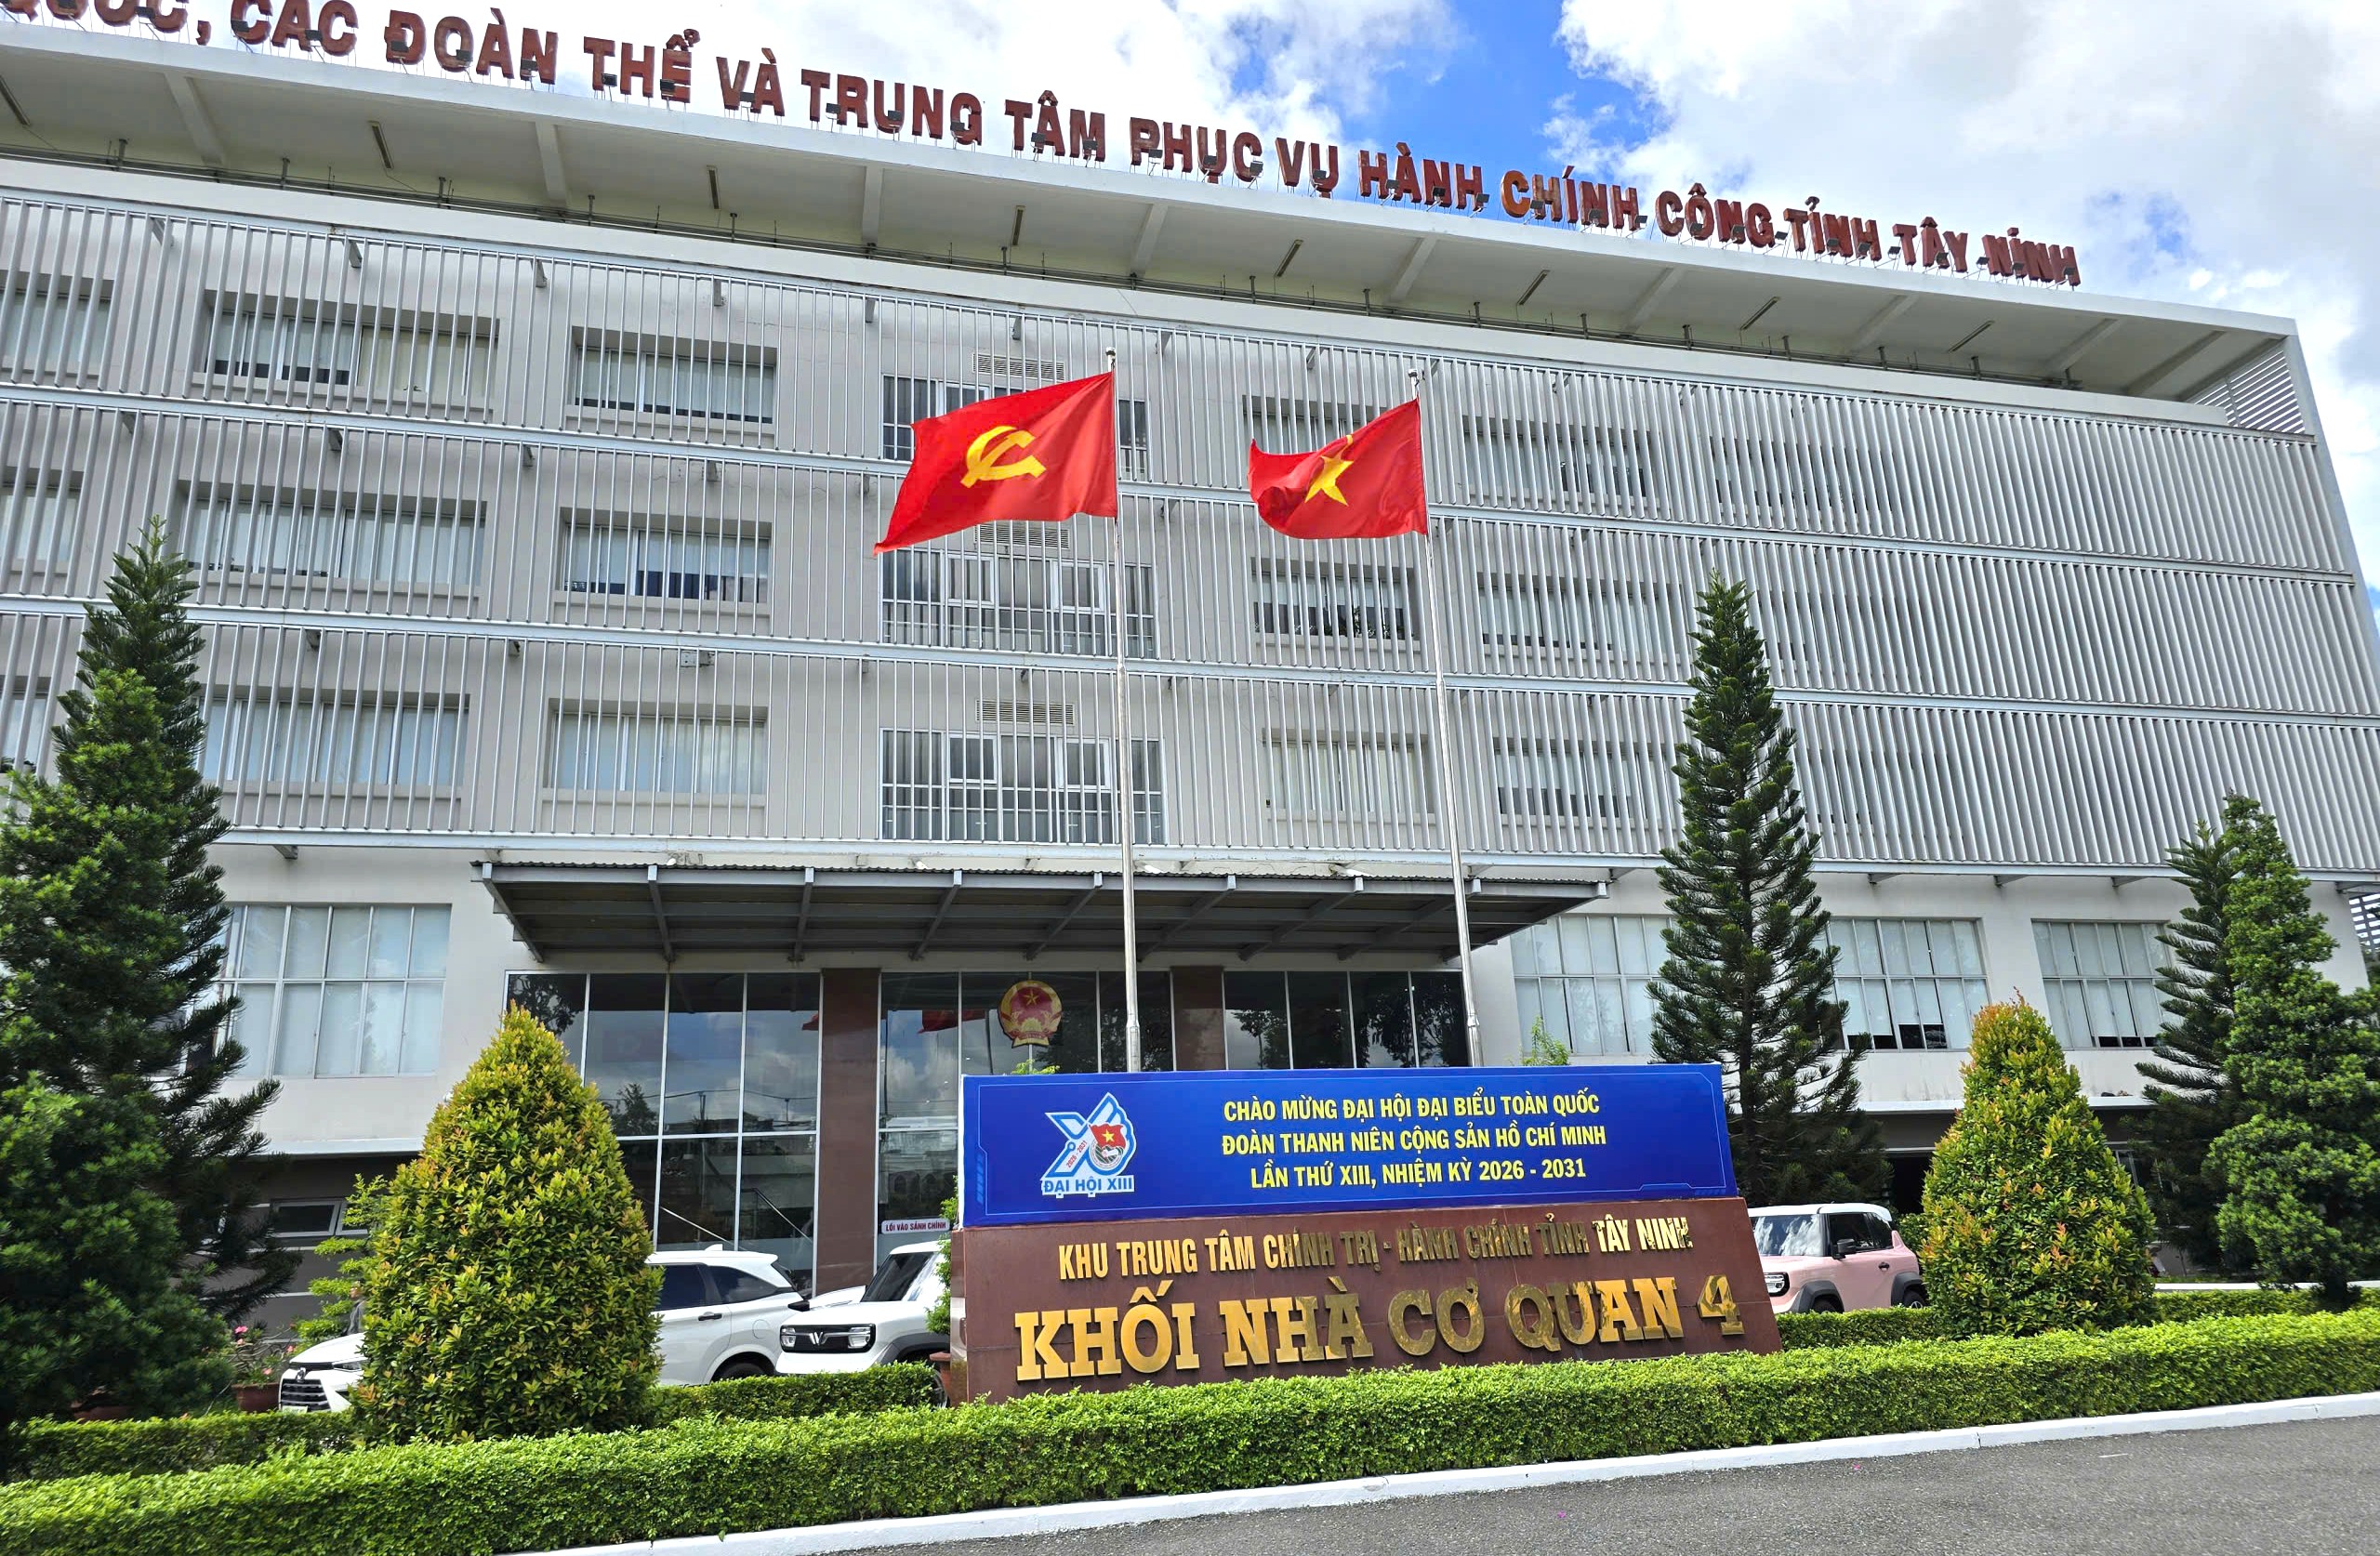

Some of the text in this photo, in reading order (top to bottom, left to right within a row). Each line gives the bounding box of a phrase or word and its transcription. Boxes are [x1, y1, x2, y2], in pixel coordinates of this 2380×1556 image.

[384, 7, 558, 85] ĐOÀN
[584, 29, 701, 103] THỂ
[715, 47, 786, 117] VÀ
[800, 69, 982, 146] TRUNG
[1004, 90, 1105, 159] TÂM
[1130, 117, 1263, 184] PHỤC
[1275, 138, 1339, 199] VỤ
[1358, 142, 1483, 212] HÀNH
[1501, 165, 1640, 231] CHÍNH
[1655, 182, 1776, 248] CÔNG
[1783, 196, 1883, 261] TỈNH
[1892, 217, 1968, 273] TÂY
[1223, 1087, 1600, 1123] CHÀO MỪNG ĐẠI HỘI ĐẠI BIỂU TOÀN QUỐC
[1222, 1119, 1606, 1154] ĐOÀN THANH NIÊN CỘNG SẢN HỒ CHÍ MINH
[1043, 1176, 1132, 1195] ĐẠI HỘI XIII
[1250, 1158, 1289, 1189] LẦN
[1294, 1160, 1333, 1187] THỨ
[1340, 1165, 1377, 1189] XIII,
[1382, 1158, 1442, 1187] NHIỆM
[1448, 1156, 1472, 1181] KỲ
[1478, 1160, 1525, 1180] 2026
[1541, 1158, 1586, 1179] 2031
[1058, 1243, 1108, 1280] KHU
[1116, 1238, 1197, 1277] TRUNG
[1204, 1229, 1256, 1272] TÂM
[1263, 1226, 1335, 1269] CHÍNH
[1340, 1230, 1382, 1272] TRỊ
[1396, 1220, 1460, 1262] HÀNH
[1463, 1218, 1533, 1259] CHÍNH
[1536, 1212, 1591, 1255] TỈNH
[1592, 1213, 1631, 1253] TÂY
[1635, 1216, 1694, 1251] NINH
[1014, 1274, 1745, 1381] KHỐI NHÀ CƠ QUAN 4
